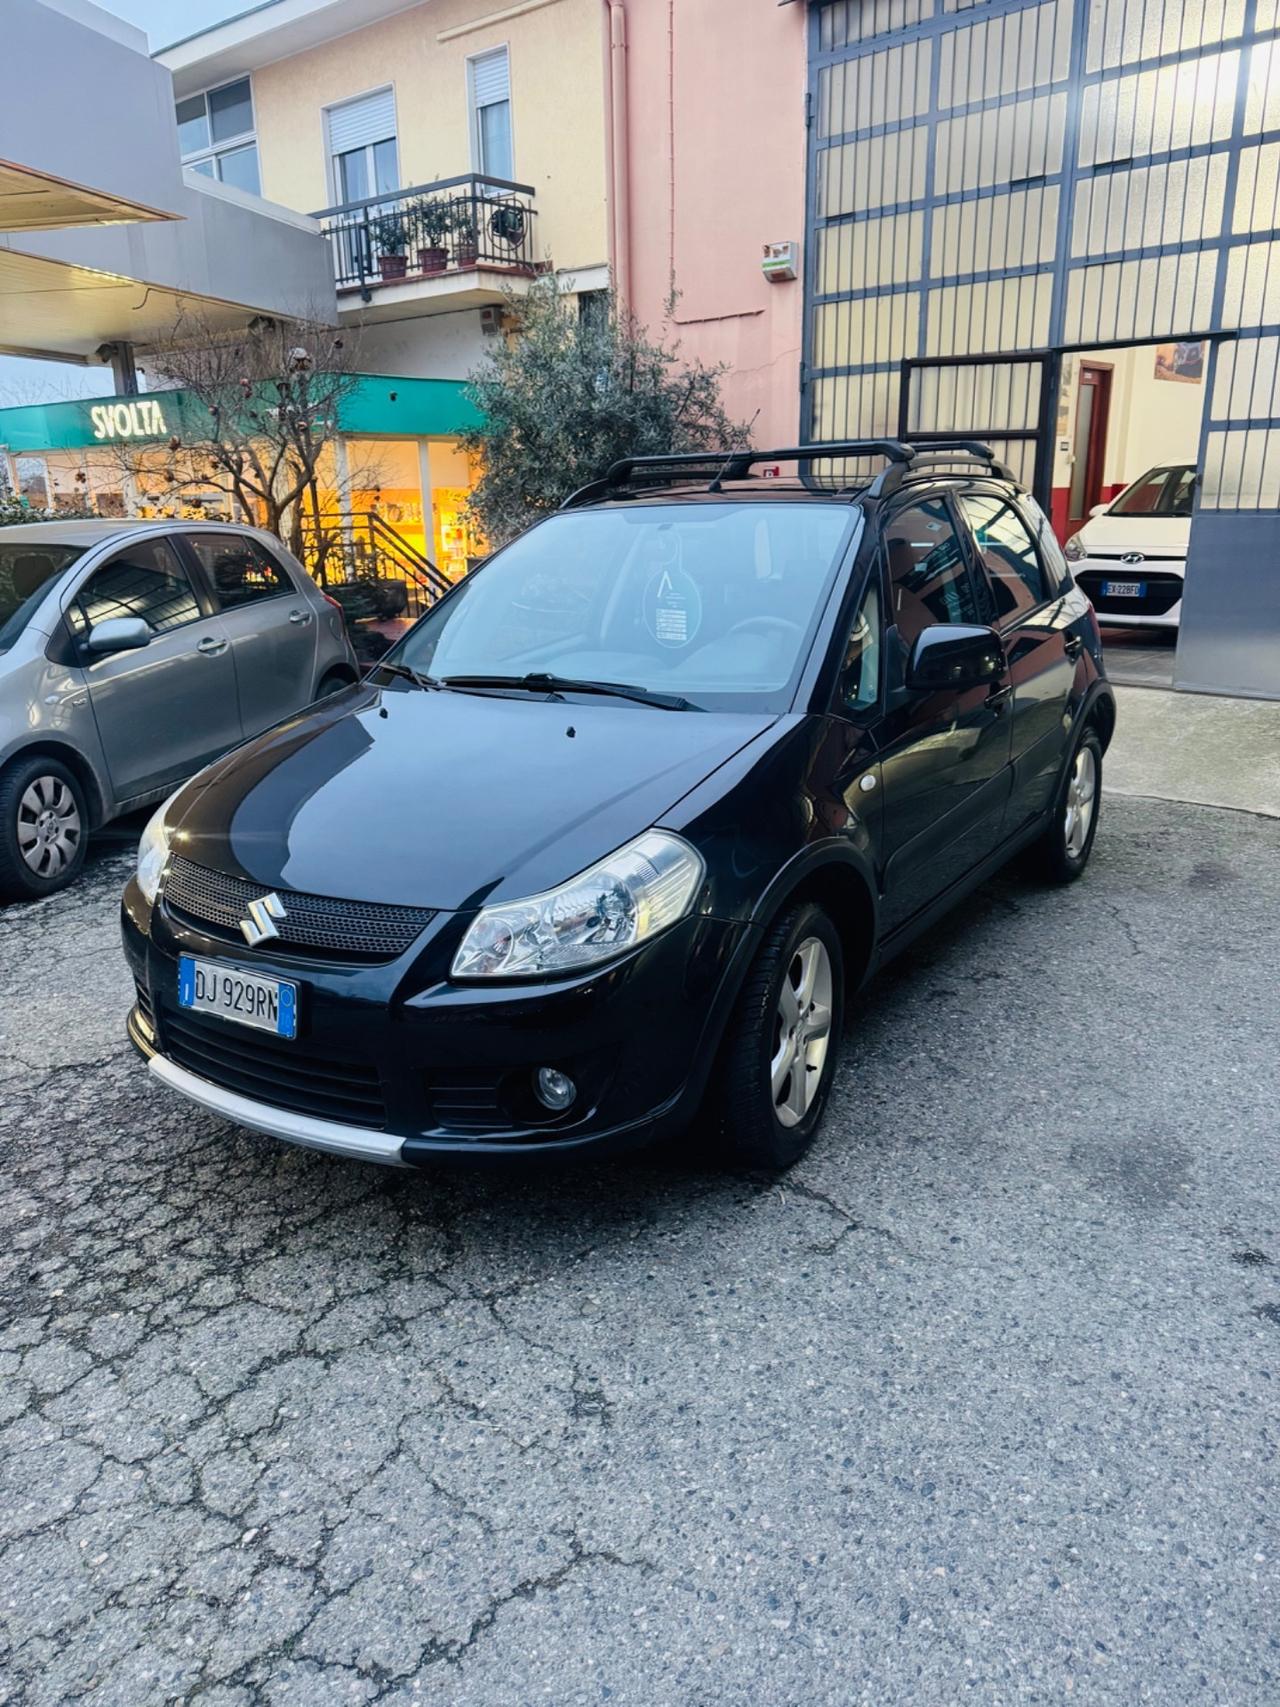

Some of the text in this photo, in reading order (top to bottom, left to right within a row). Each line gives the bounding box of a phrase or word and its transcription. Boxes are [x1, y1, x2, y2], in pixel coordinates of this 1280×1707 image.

[91, 400, 168, 439] SVOLTA
[195, 969, 278, 1022] DJ 929RN
